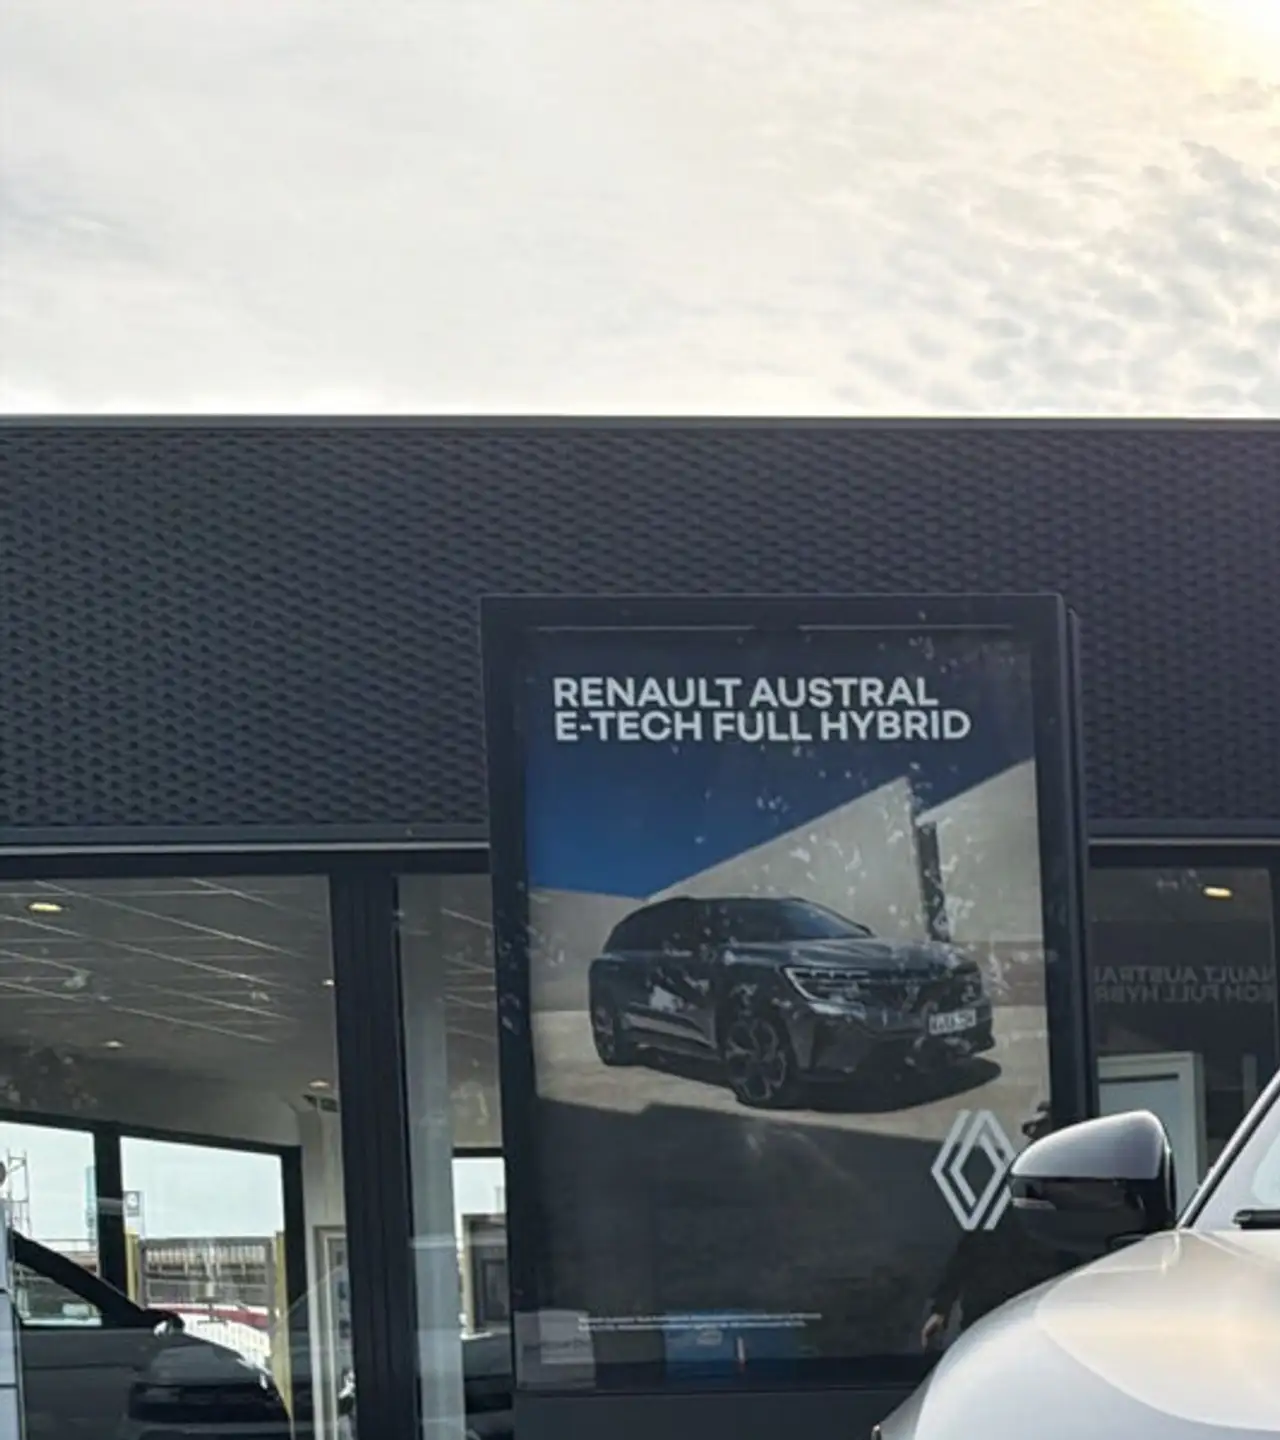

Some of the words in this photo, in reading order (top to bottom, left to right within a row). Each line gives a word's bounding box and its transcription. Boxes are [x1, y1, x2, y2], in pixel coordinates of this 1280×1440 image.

[553, 677, 742, 708] RENAULT
[749, 676, 940, 707] AUSTRAL
[555, 711, 702, 742] E-TECH
[713, 710, 812, 741] FULL
[820, 709, 972, 740] HYBRID
